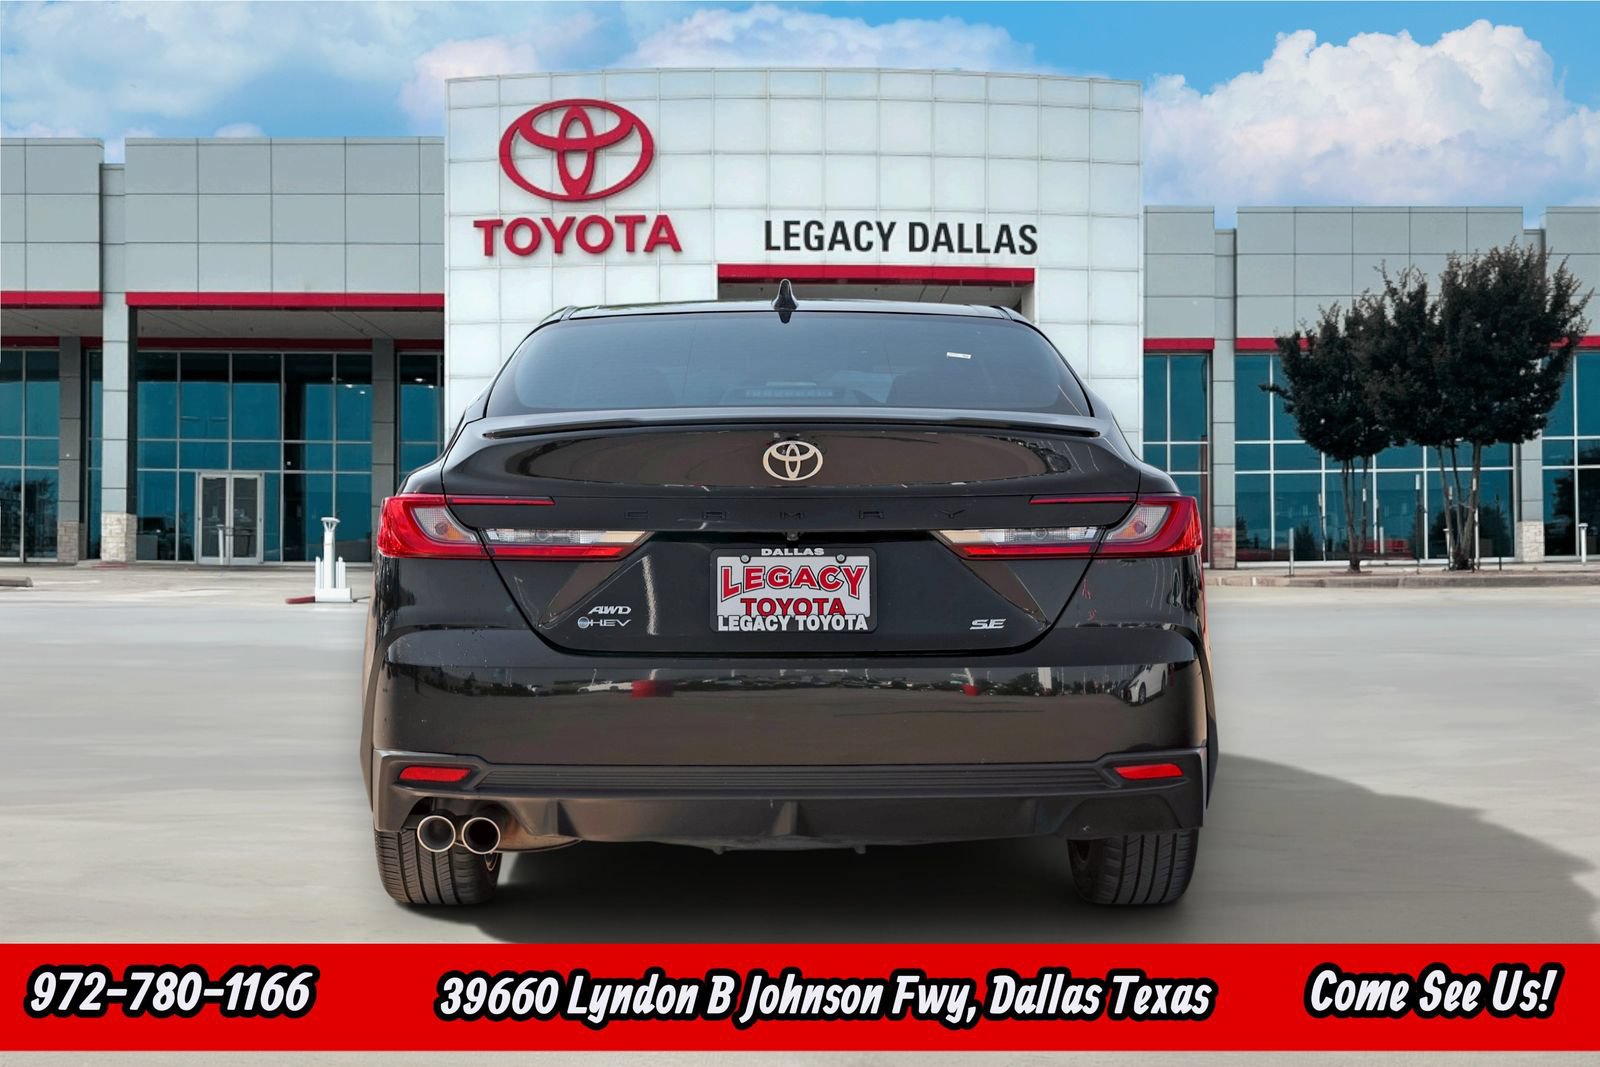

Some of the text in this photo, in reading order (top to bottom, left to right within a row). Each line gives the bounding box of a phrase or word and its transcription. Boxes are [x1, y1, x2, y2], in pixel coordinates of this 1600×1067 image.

[473, 214, 682, 257] TOYOTA
[765, 220, 1038, 255] LEGACY DALLAS
[624, 508, 966, 520] CAMRY
[761, 548, 824, 556] DALLAS
[721, 565, 868, 602] LEGACY
[588, 606, 632, 615] AWD
[740, 597, 846, 618] TOYOTA
[718, 614, 868, 631] LEGACY TOYOTA
[969, 618, 1007, 630] SE
